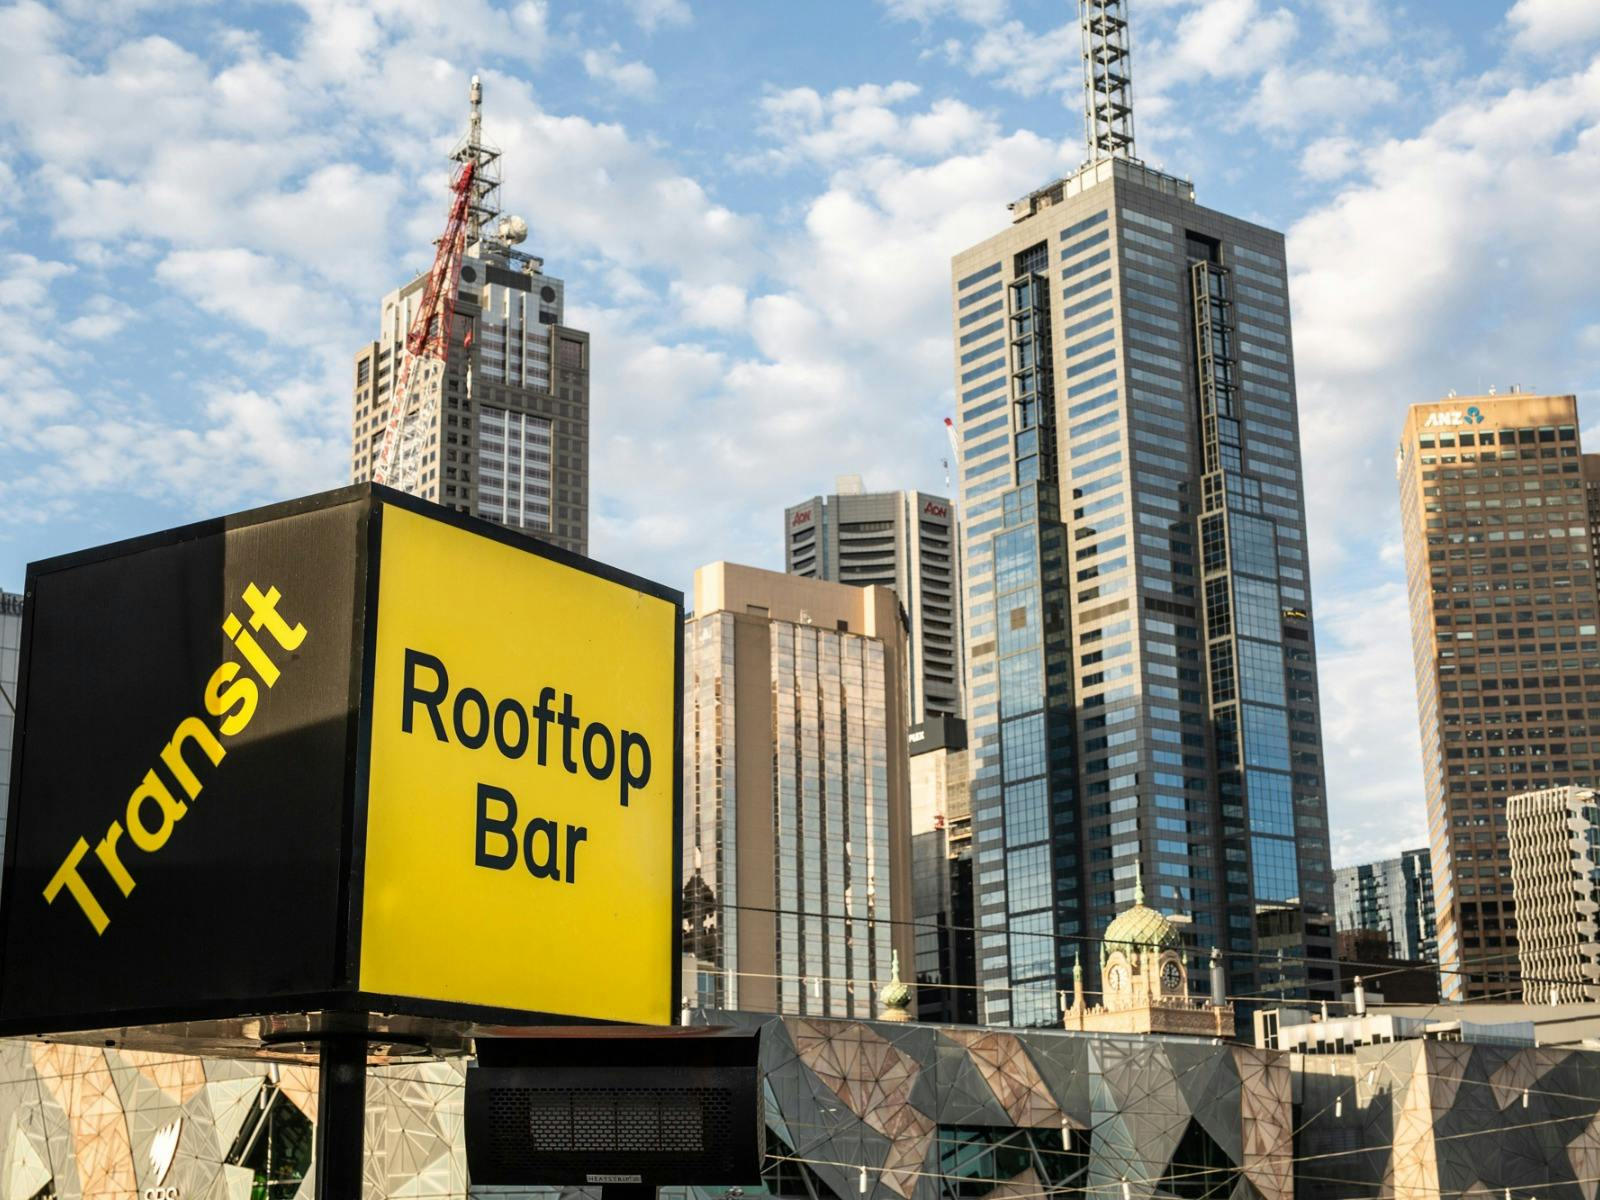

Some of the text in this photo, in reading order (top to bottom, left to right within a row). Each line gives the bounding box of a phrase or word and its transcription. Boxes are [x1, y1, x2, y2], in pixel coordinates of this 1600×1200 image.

[1425, 410, 1464, 427] ANZ
[42, 581, 308, 936] Transit
[401, 648, 652, 807] Rooftop
[475, 782, 588, 884] Bar
